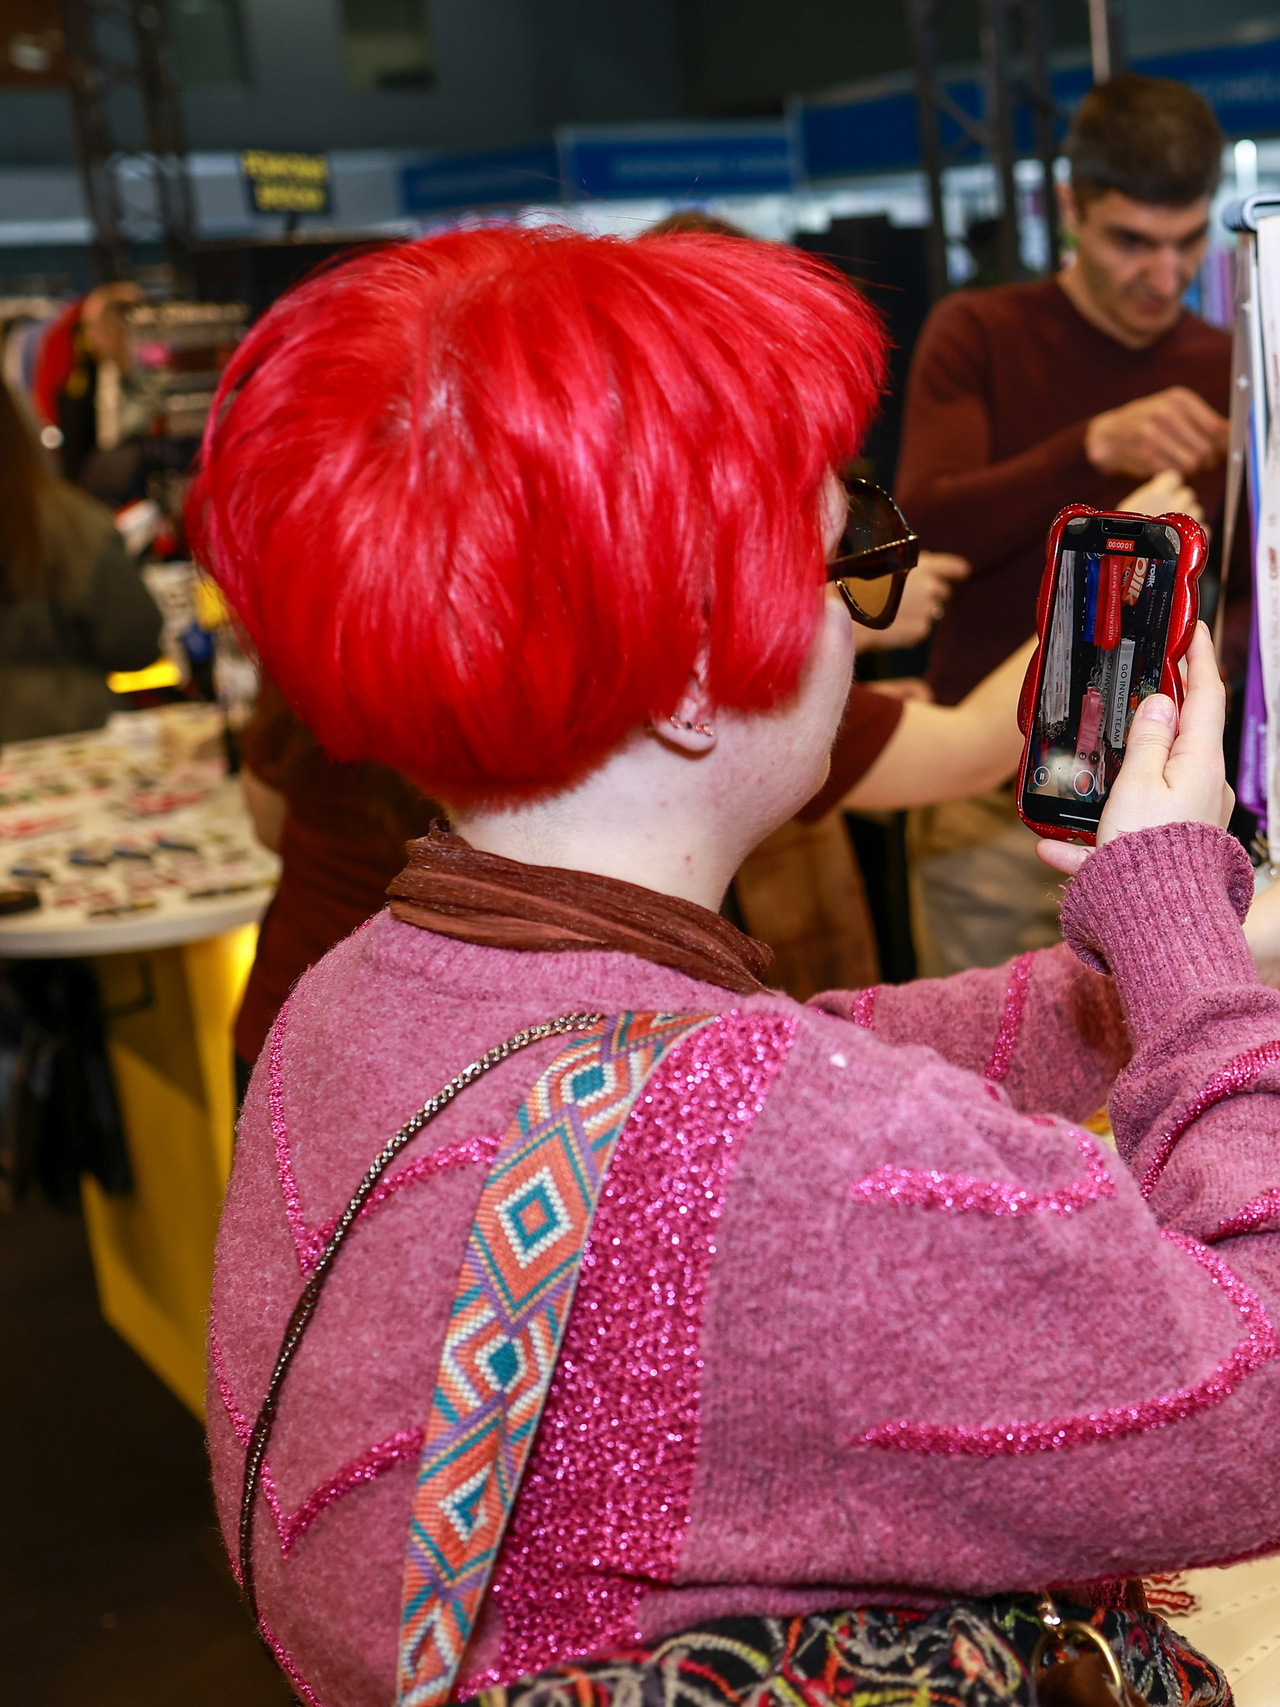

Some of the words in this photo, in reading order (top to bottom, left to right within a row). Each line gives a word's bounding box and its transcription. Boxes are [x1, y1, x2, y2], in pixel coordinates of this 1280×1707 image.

[1107, 540, 1133, 550] 00:00:01
[1125, 558, 1148, 606] olik
[1146, 564, 1156, 588] rolik
[1121, 664, 1128, 679] GO
[1116, 680, 1127, 715] INVEST
[1113, 718, 1123, 743] TEAM
